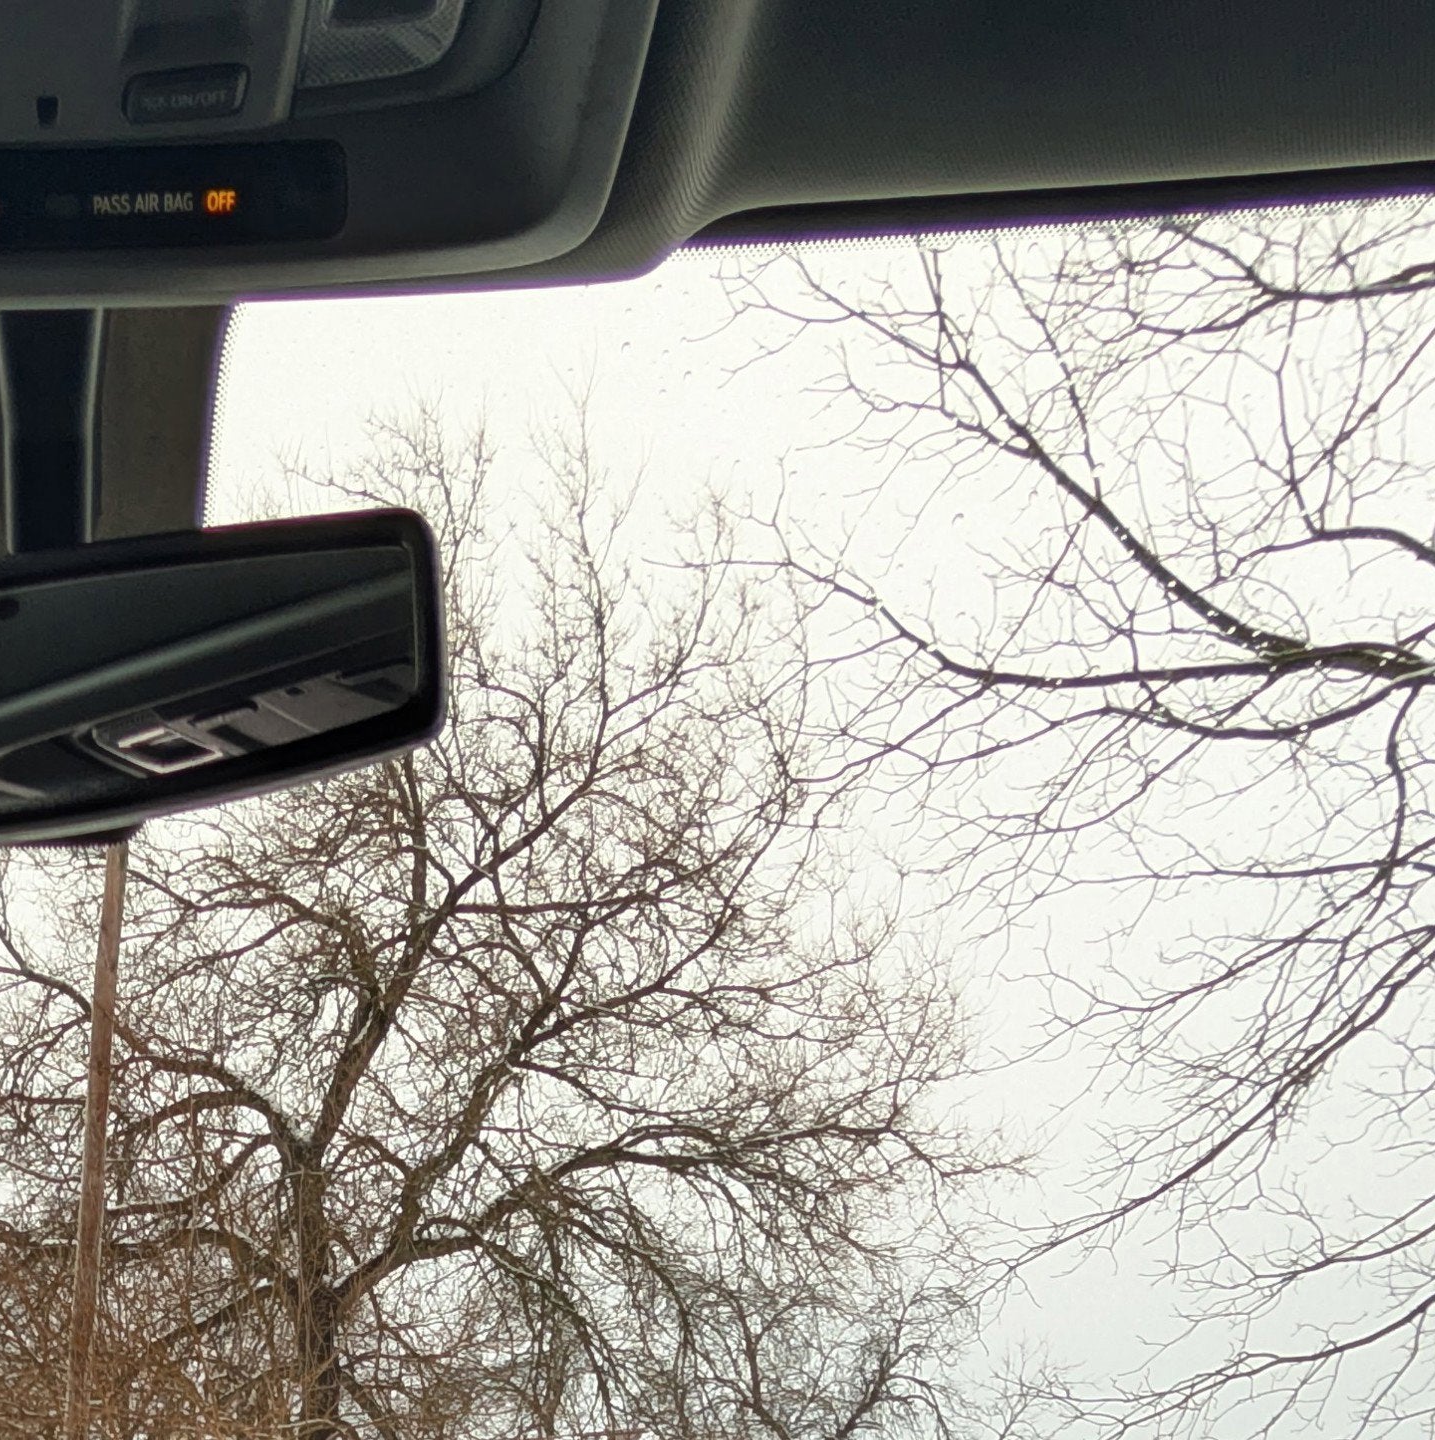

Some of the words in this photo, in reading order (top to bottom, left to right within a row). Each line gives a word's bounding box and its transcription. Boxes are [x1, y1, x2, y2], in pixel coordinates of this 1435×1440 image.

[92, 193, 131, 215] PASS
[134, 191, 160, 213] AIR
[164, 190, 194, 212] BAG
[205, 189, 237, 212] OFF
